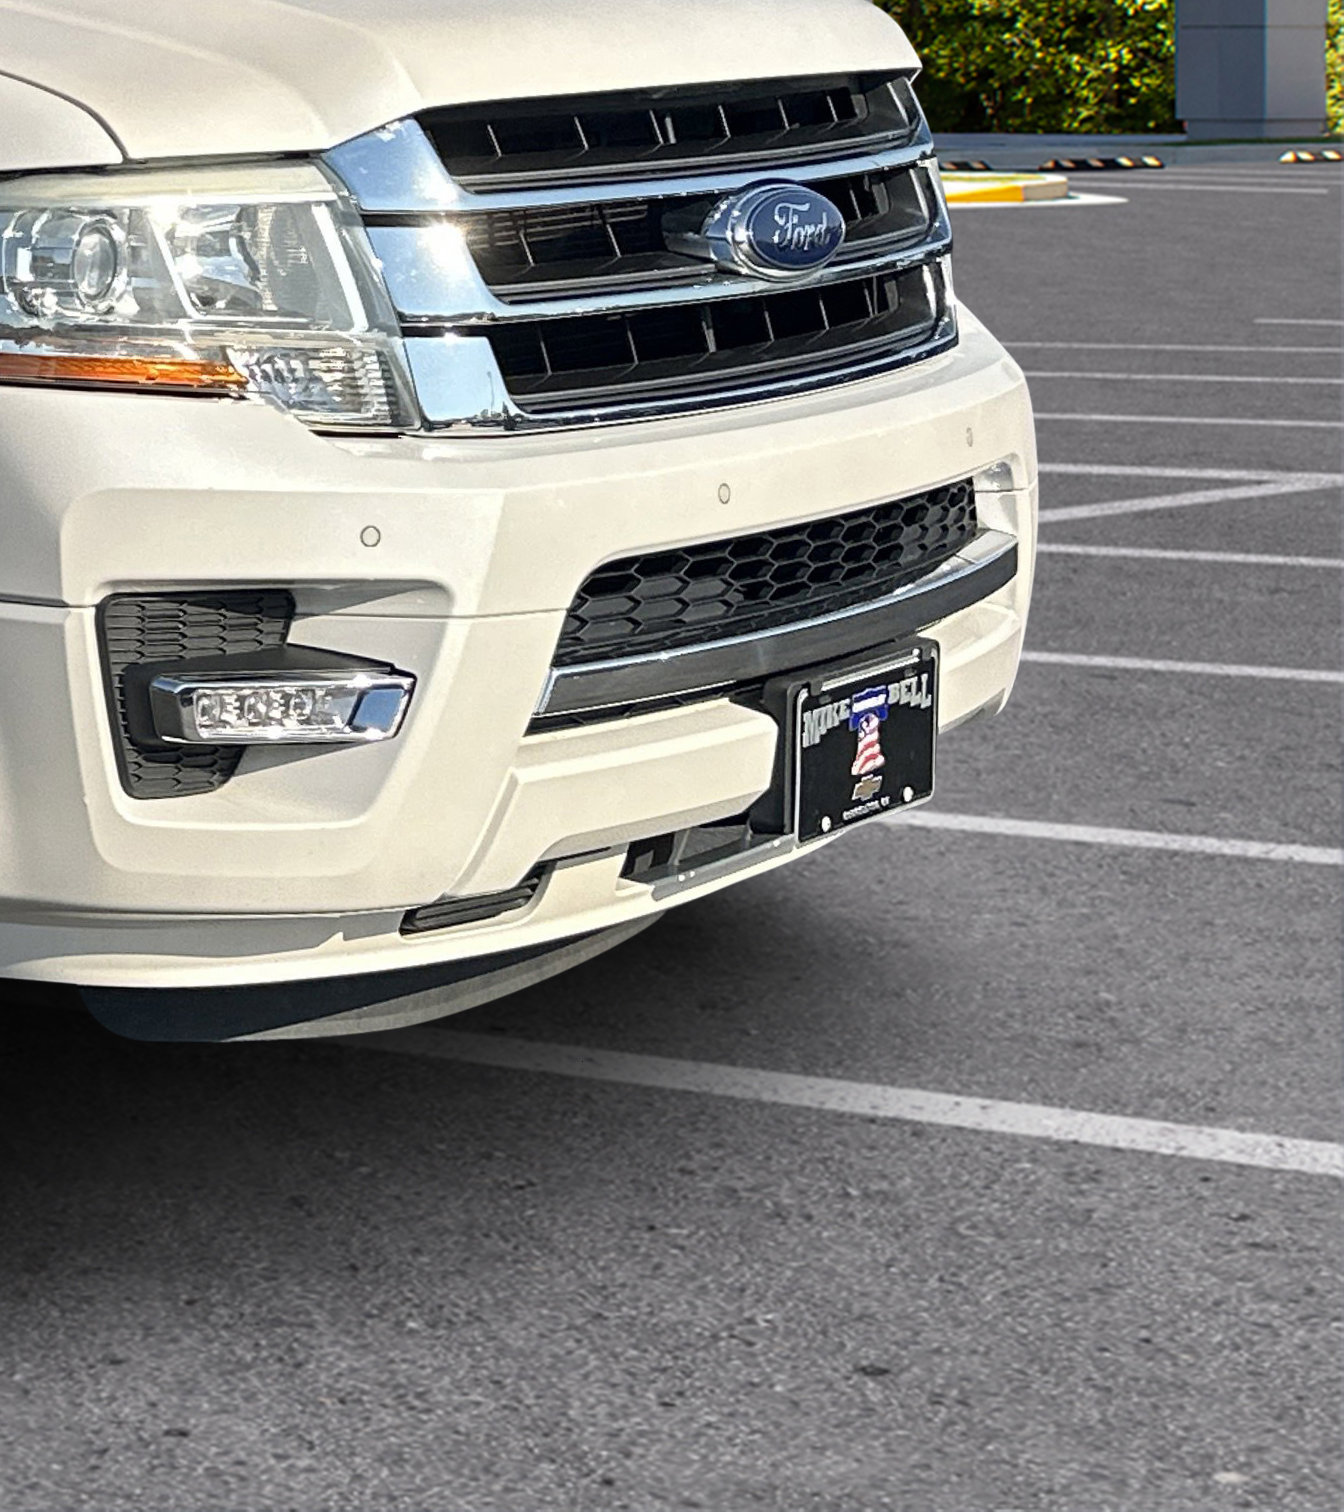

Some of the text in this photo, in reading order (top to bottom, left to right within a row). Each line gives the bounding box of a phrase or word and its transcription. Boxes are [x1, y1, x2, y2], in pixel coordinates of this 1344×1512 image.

[773, 202, 831, 251] Ford
[803, 674, 931, 748] MIKE BELL
